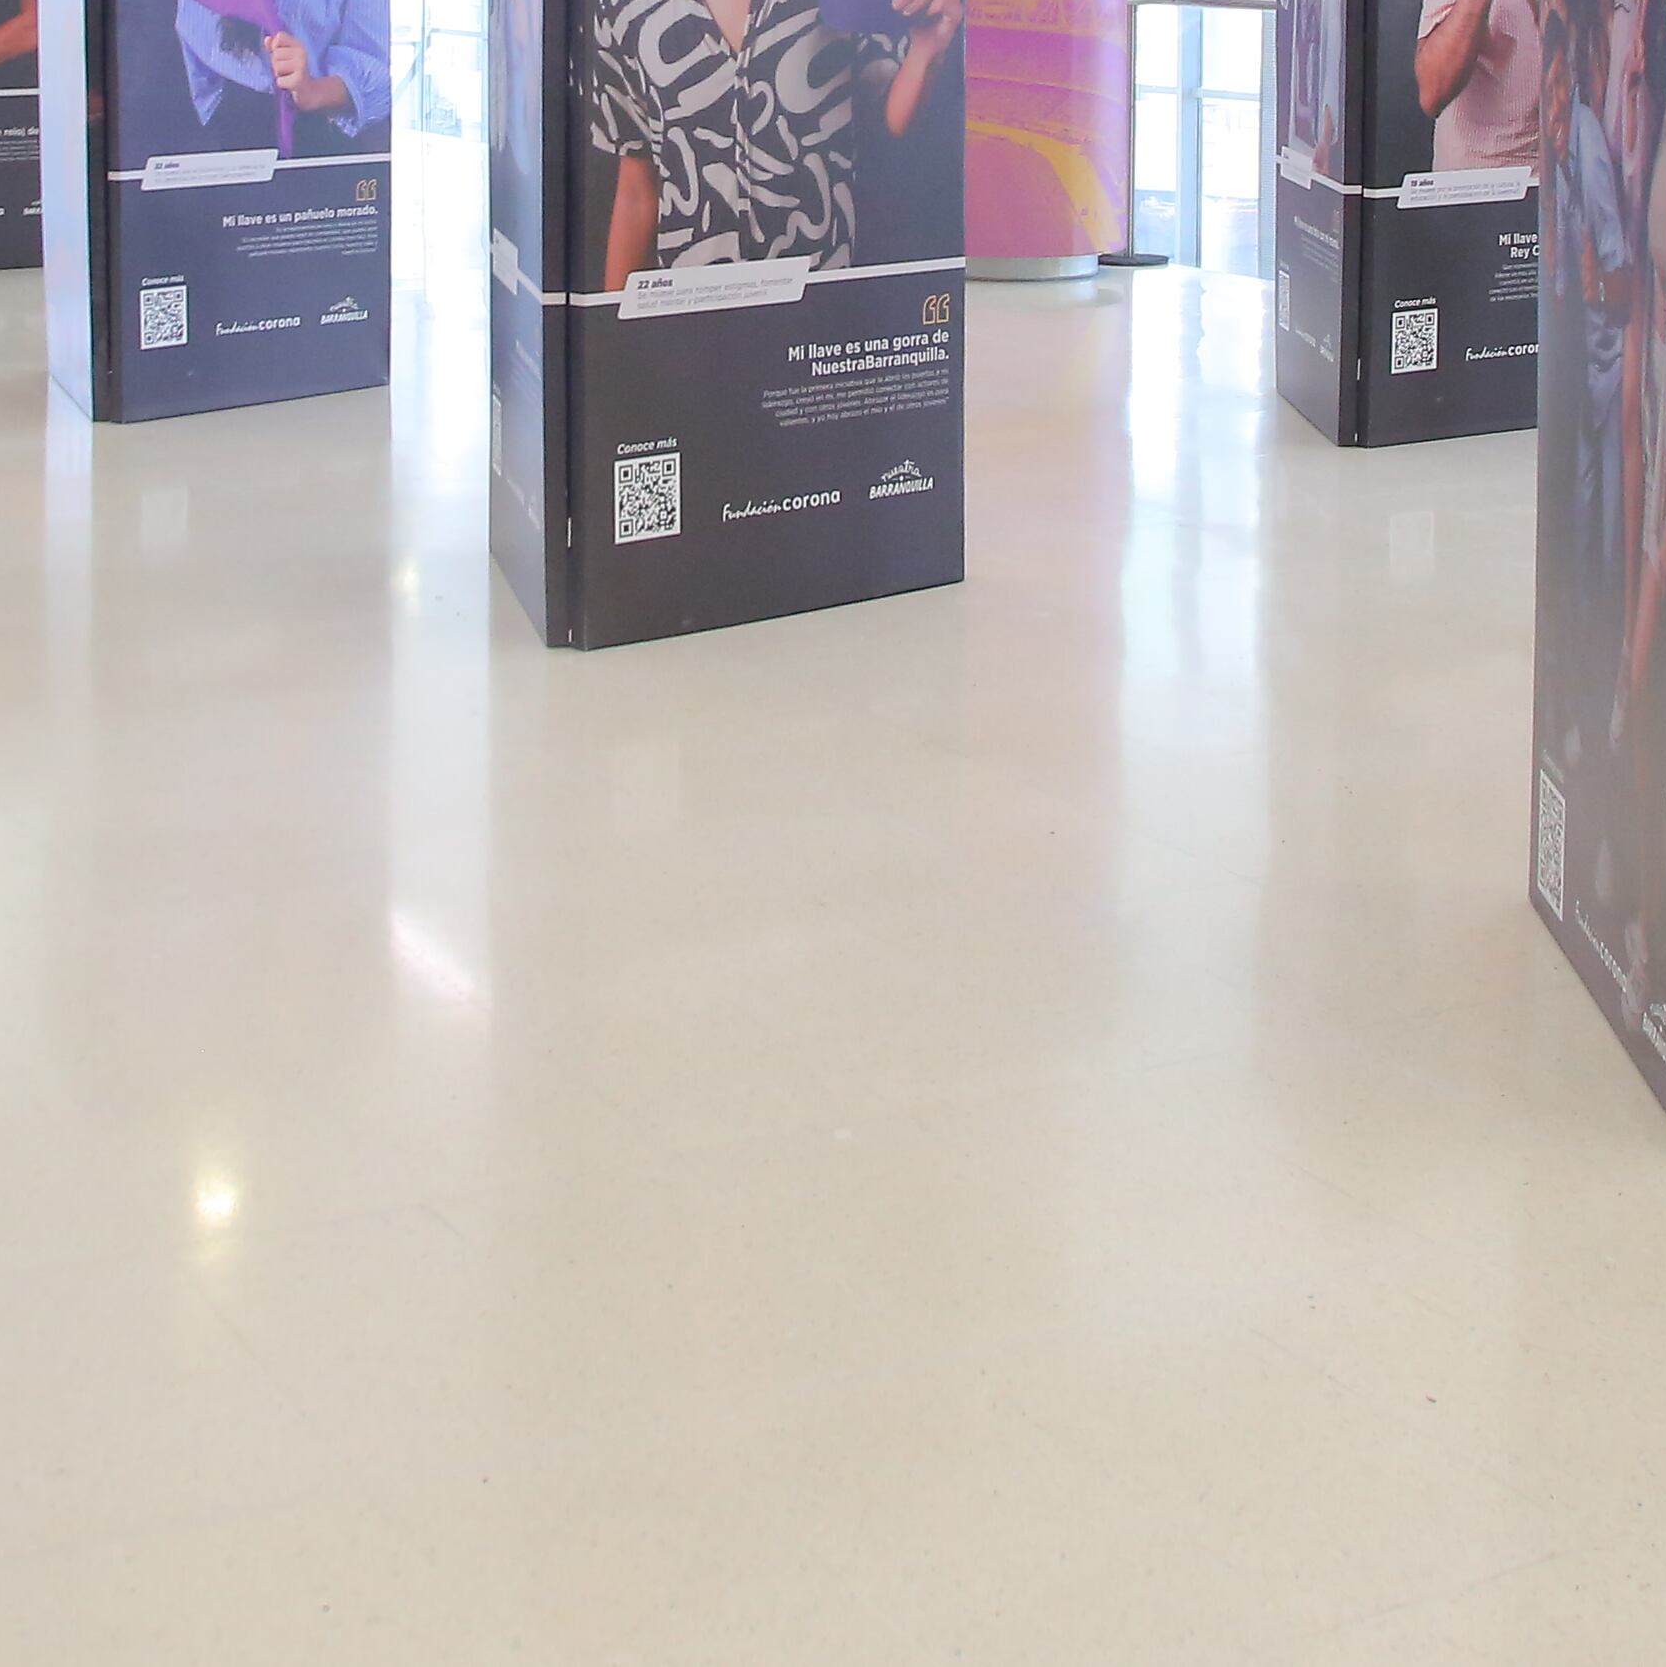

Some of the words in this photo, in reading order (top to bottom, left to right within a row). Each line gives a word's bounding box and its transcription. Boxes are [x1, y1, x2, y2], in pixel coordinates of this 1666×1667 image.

[223, 215, 236, 227] Mi
[238, 215, 263, 226] llave
[265, 214, 277, 224] es
[279, 213, 292, 222] un
[336, 205, 379, 217] morado.
[1499, 233, 1511, 246] Mi
[1514, 231, 1537, 246] llave
[1510, 247, 1530, 259] Rey
[637, 280, 650, 290] 22
[651, 278, 673, 288] años
[1394, 299, 1421, 308] Conoce
[257, 317, 301, 331] corona
[788, 346, 804, 362] Mi
[808, 343, 841, 359] llave
[845, 342, 861, 354] es
[864, 339, 889, 352] una
[893, 333, 928, 351] gorra
[932, 330, 950, 344] de
[811, 347, 950, 376] NuestraBarranquilla.
[617, 442, 655, 454] Conoce
[656, 437, 677, 449] más
[869, 477, 934, 500] BARRANQUILLA
[782, 490, 841, 512] corona
